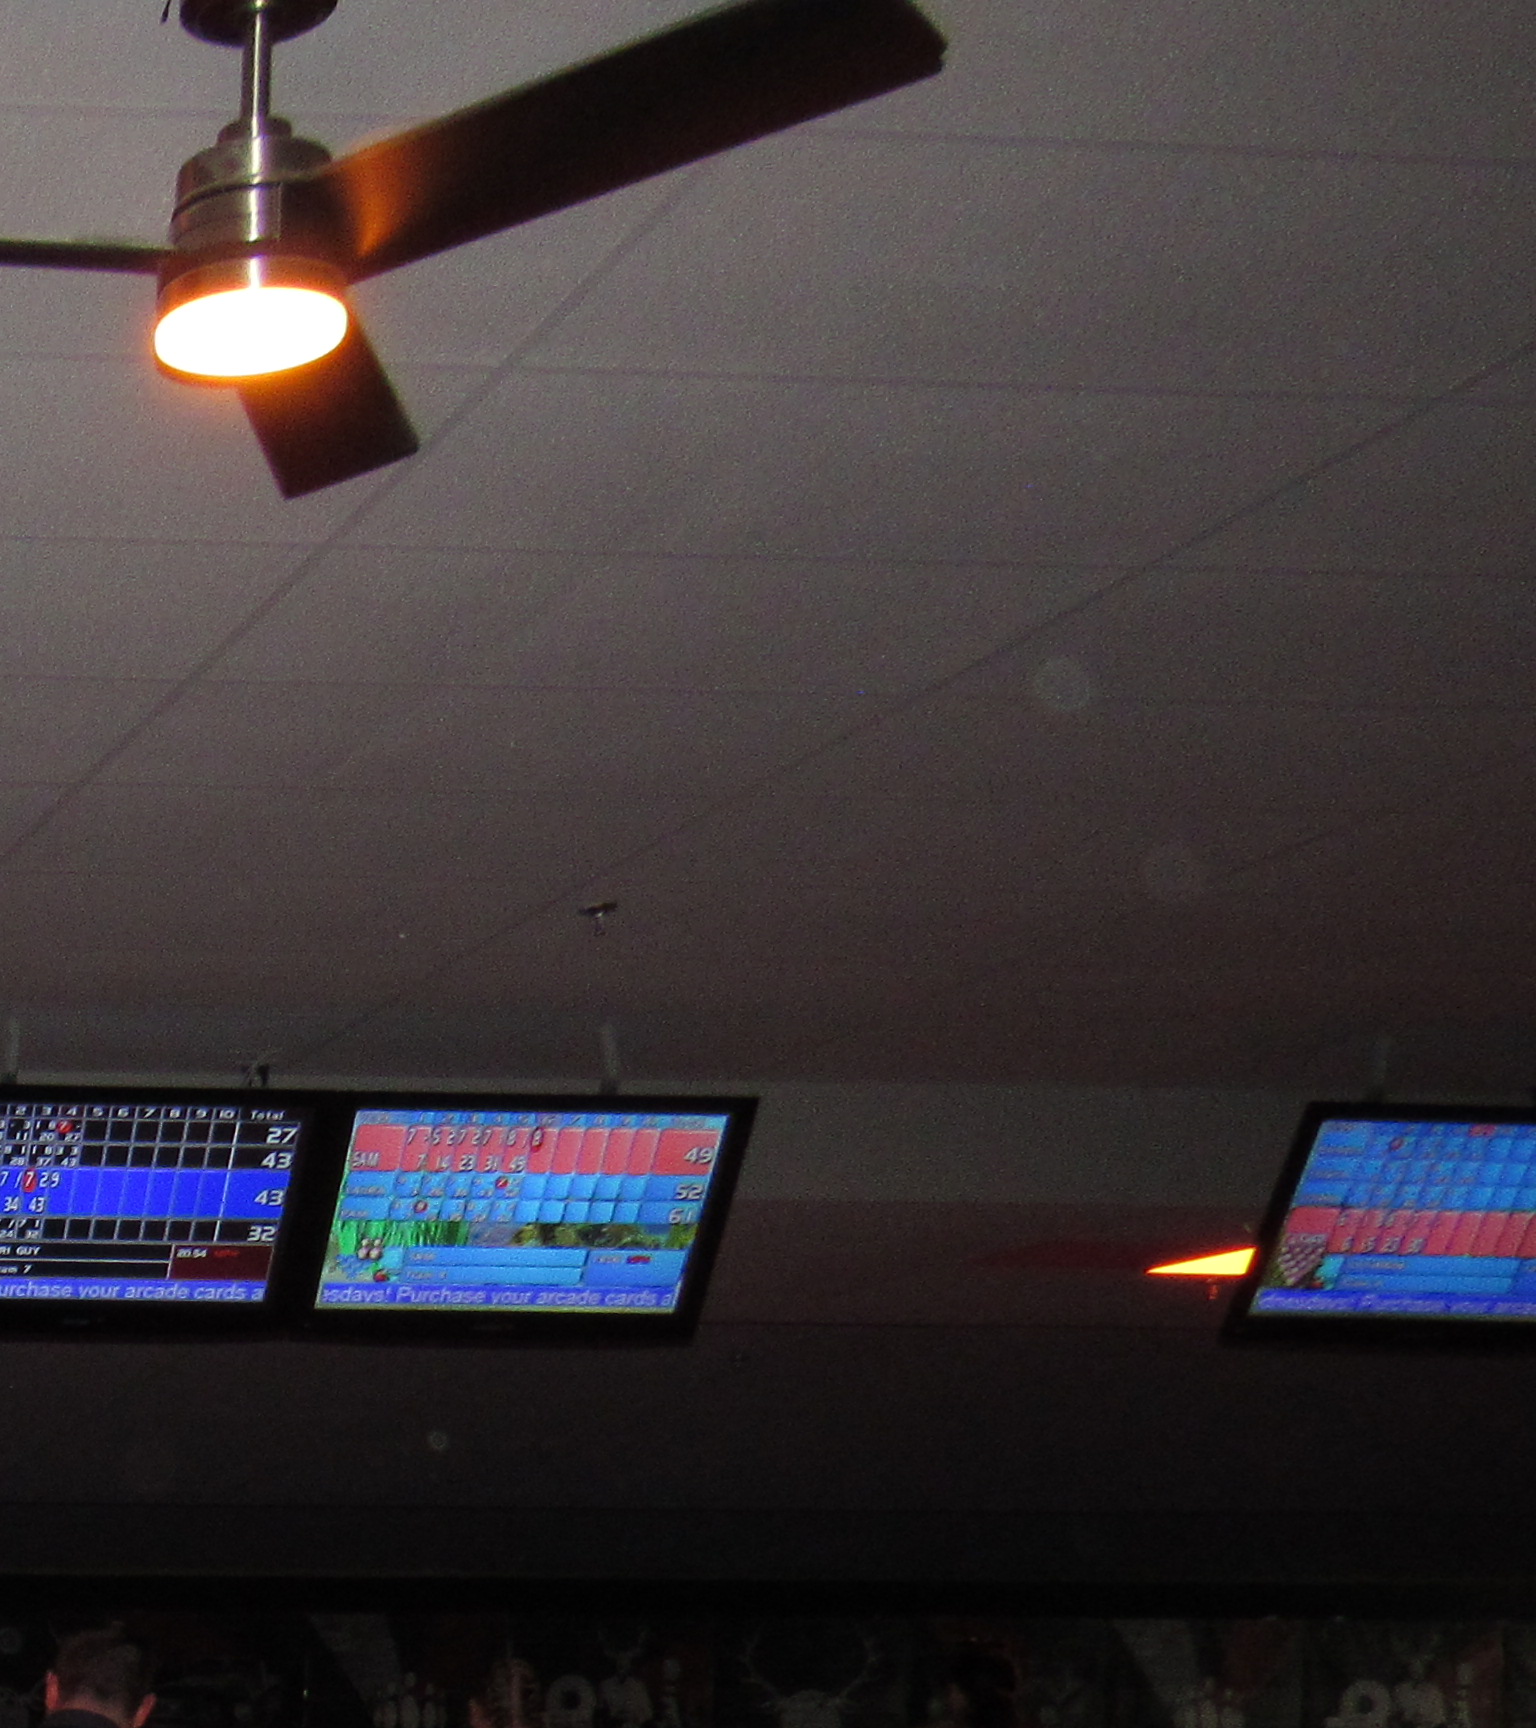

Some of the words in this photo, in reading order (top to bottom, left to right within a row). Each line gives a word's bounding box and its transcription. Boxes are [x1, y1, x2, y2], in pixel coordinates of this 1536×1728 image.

[250, 1109, 286, 1121] Total
[266, 1127, 298, 1144] 27
[261, 1152, 293, 1169] 43
[683, 1147, 713, 1164] 49
[676, 1184, 704, 1199] 52
[3, 1196, 19, 1212] 34
[28, 1197, 45, 1213] 43
[253, 1189, 285, 1206] 43
[668, 1208, 694, 1224] 61
[247, 1225, 277, 1241] 32
[78, 1284, 122, 1299] your
[125, 1283, 190, 1299] arcade
[194, 1284, 247, 1300] cards
[396, 1286, 487, 1303] Purchase
[491, 1291, 529, 1306] your
[536, 1290, 603, 1306] arcade
[605, 1291, 658, 1306] cards
